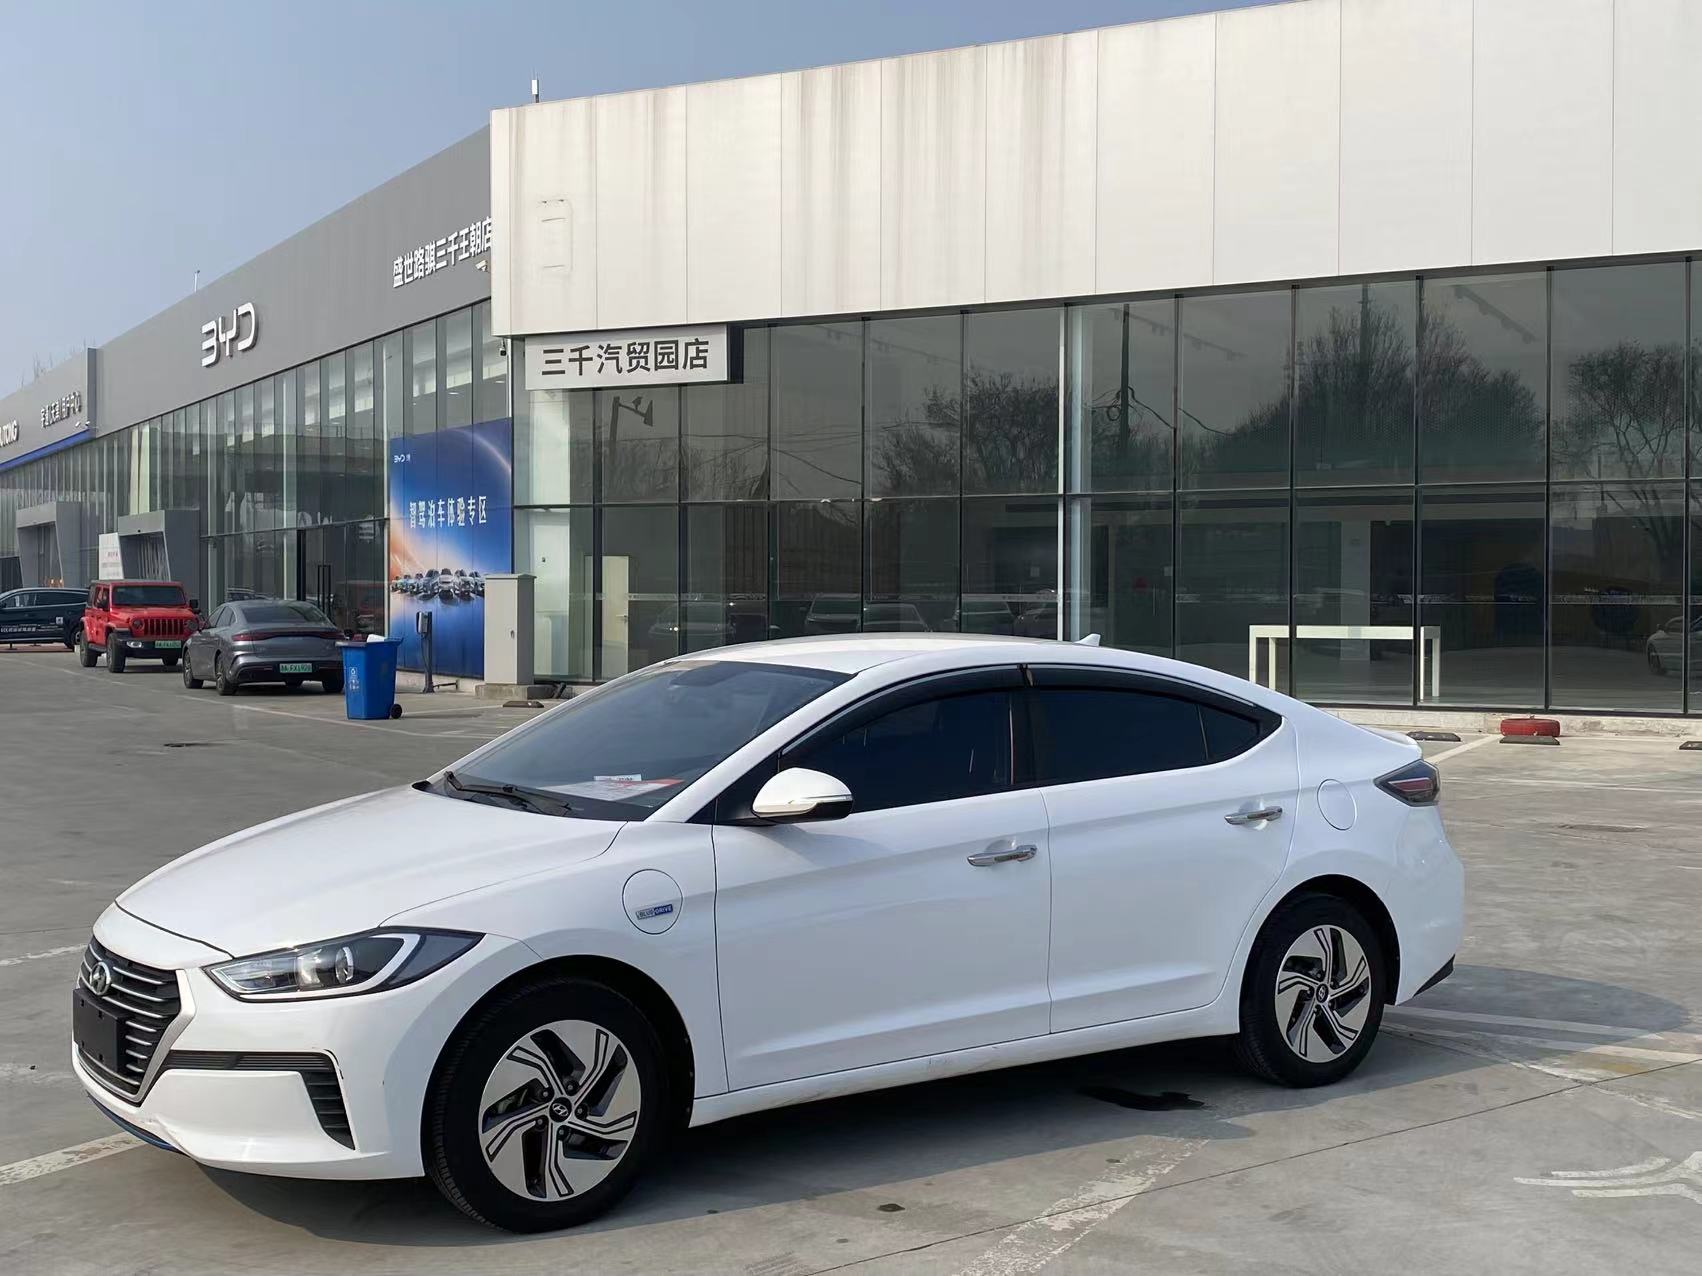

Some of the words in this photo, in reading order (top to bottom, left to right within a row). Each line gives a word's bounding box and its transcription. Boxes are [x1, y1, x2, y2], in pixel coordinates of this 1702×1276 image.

[201, 302, 255, 367] BYD
[541, 338, 709, 376] 三千汽贸园店
[409, 496, 487, 528] 智驾泊车体验专区
